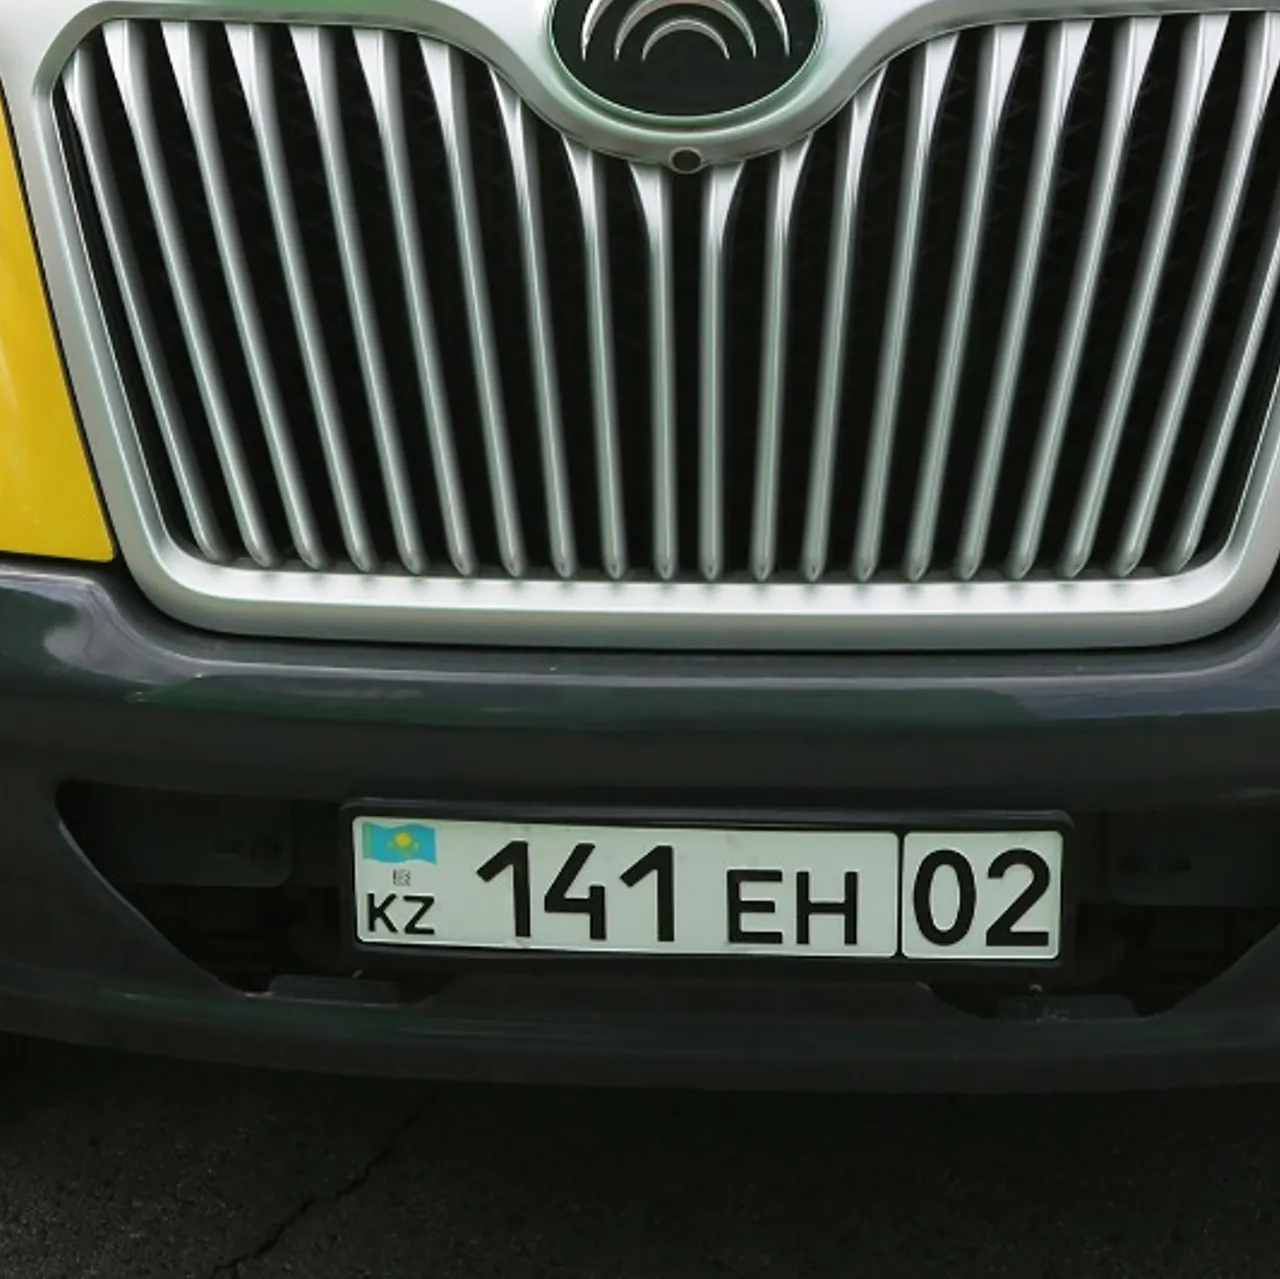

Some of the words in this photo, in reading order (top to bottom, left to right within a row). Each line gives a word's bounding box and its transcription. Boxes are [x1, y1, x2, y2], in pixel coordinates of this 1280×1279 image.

[367, 892, 435, 935] KZ
[476, 841, 675, 942] 141
[727, 869, 858, 945] EH
[913, 850, 1051, 947] 02
